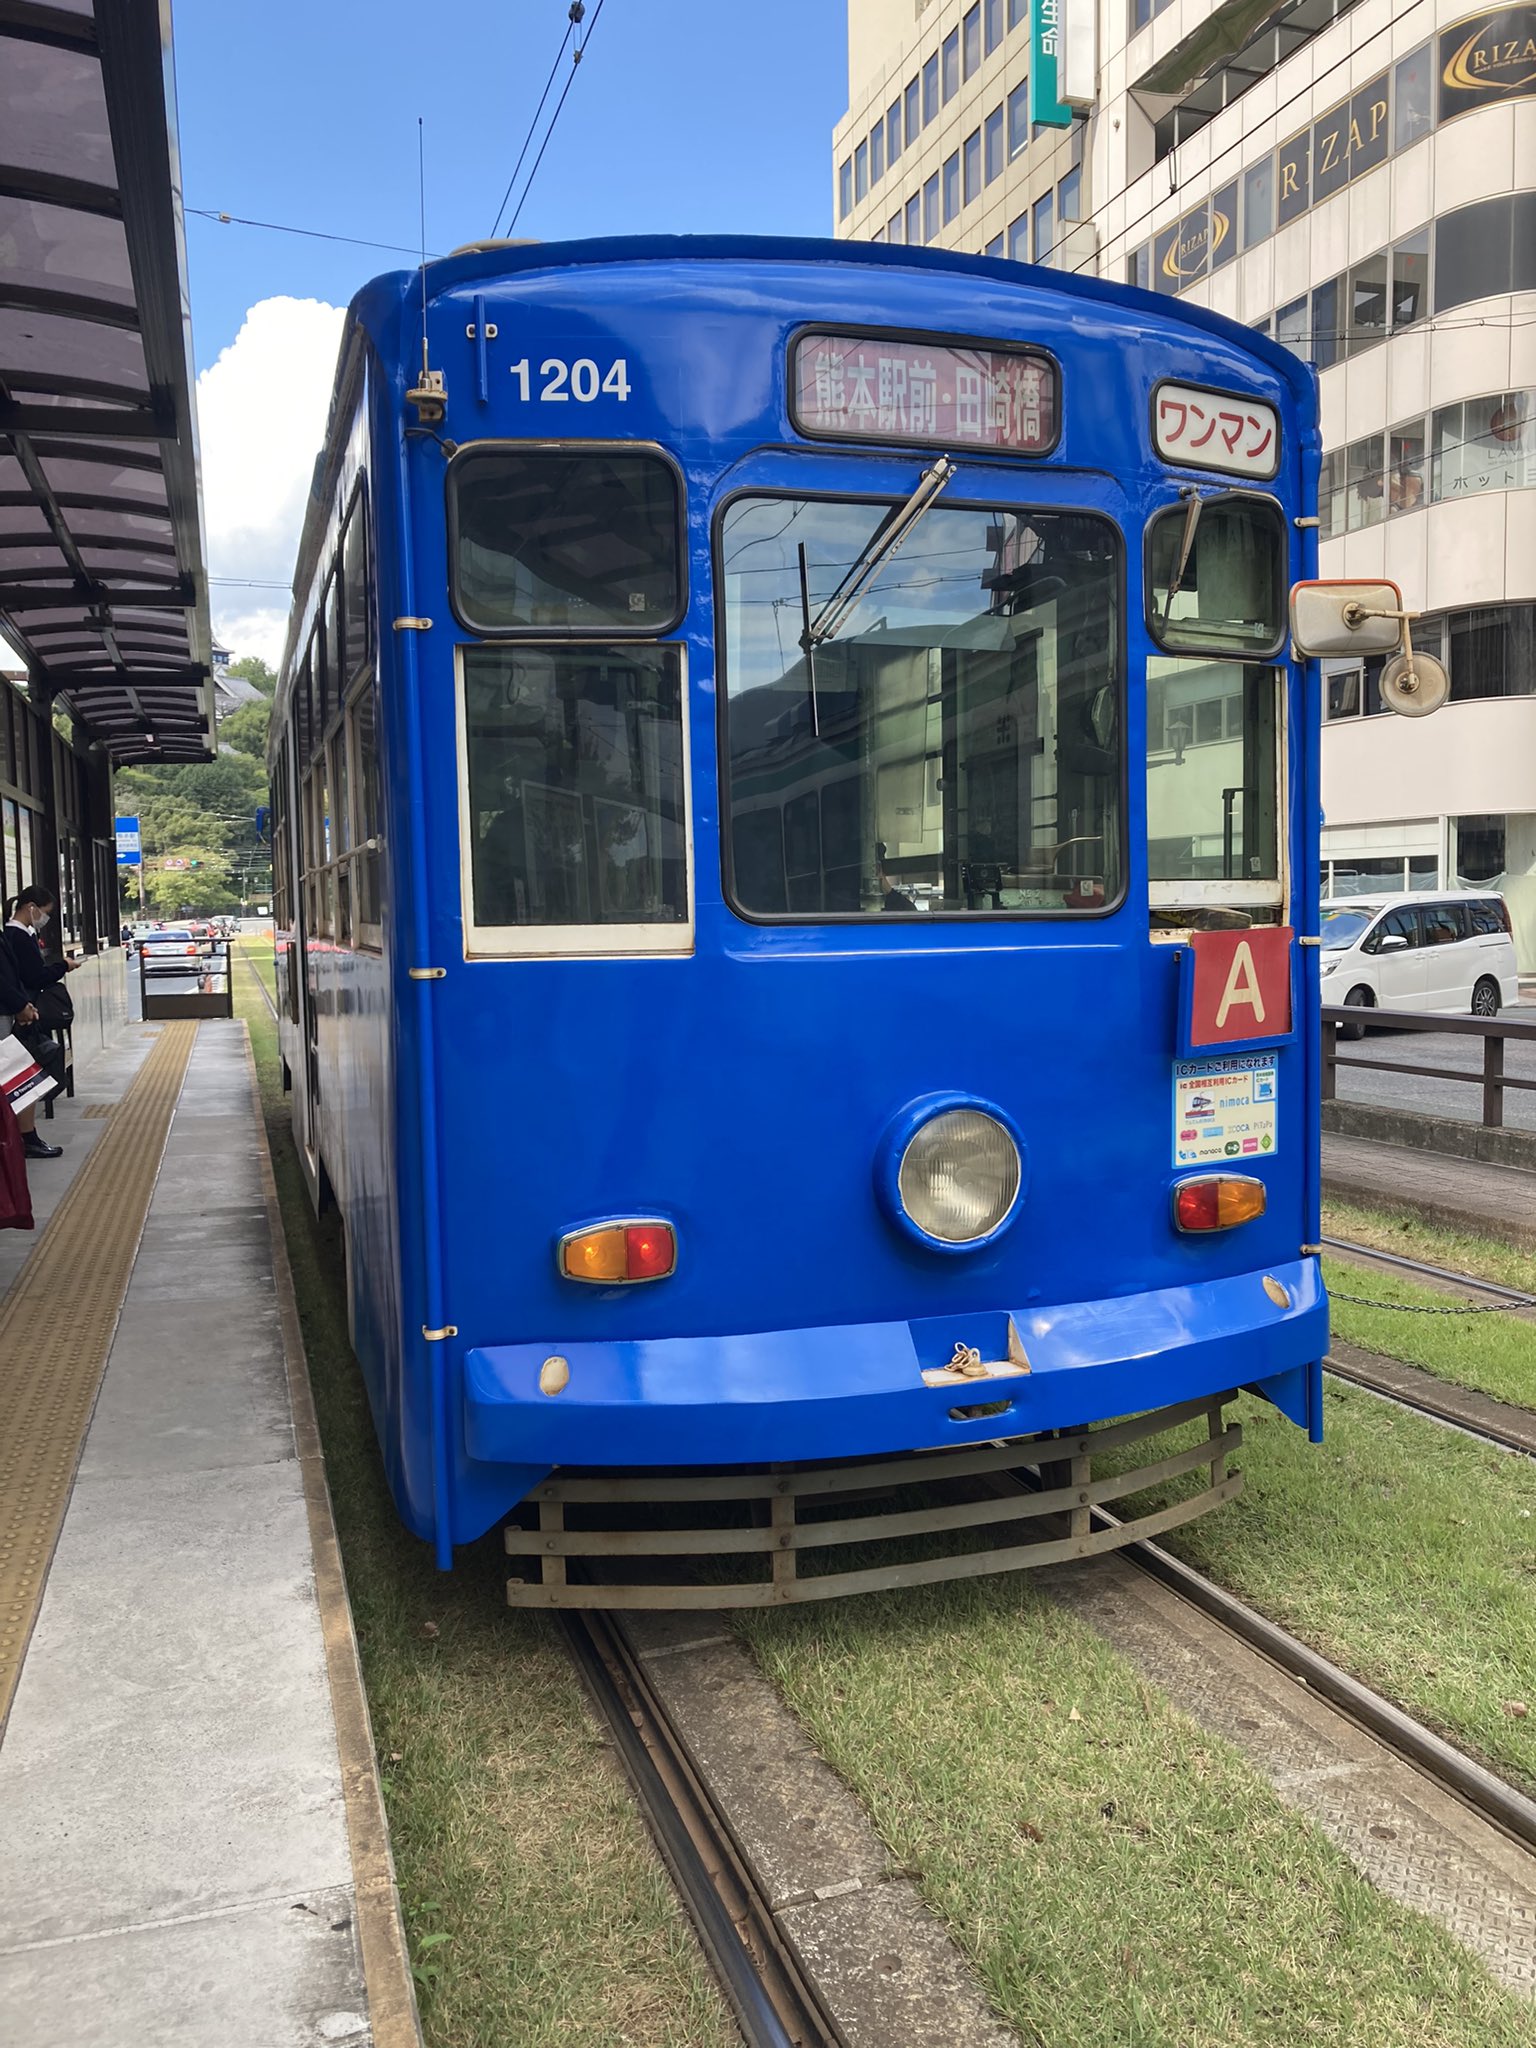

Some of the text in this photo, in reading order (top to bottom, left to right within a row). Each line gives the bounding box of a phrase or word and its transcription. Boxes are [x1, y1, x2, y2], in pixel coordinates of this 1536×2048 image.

[510, 358, 632, 402] 1204
[1160, 400, 1272, 458] ワンマン
[1215, 940, 1266, 1028] A
[1176, 1056, 1275, 1075] ICカードご利用になれます
[1219, 1096, 1250, 1108] nimoca
